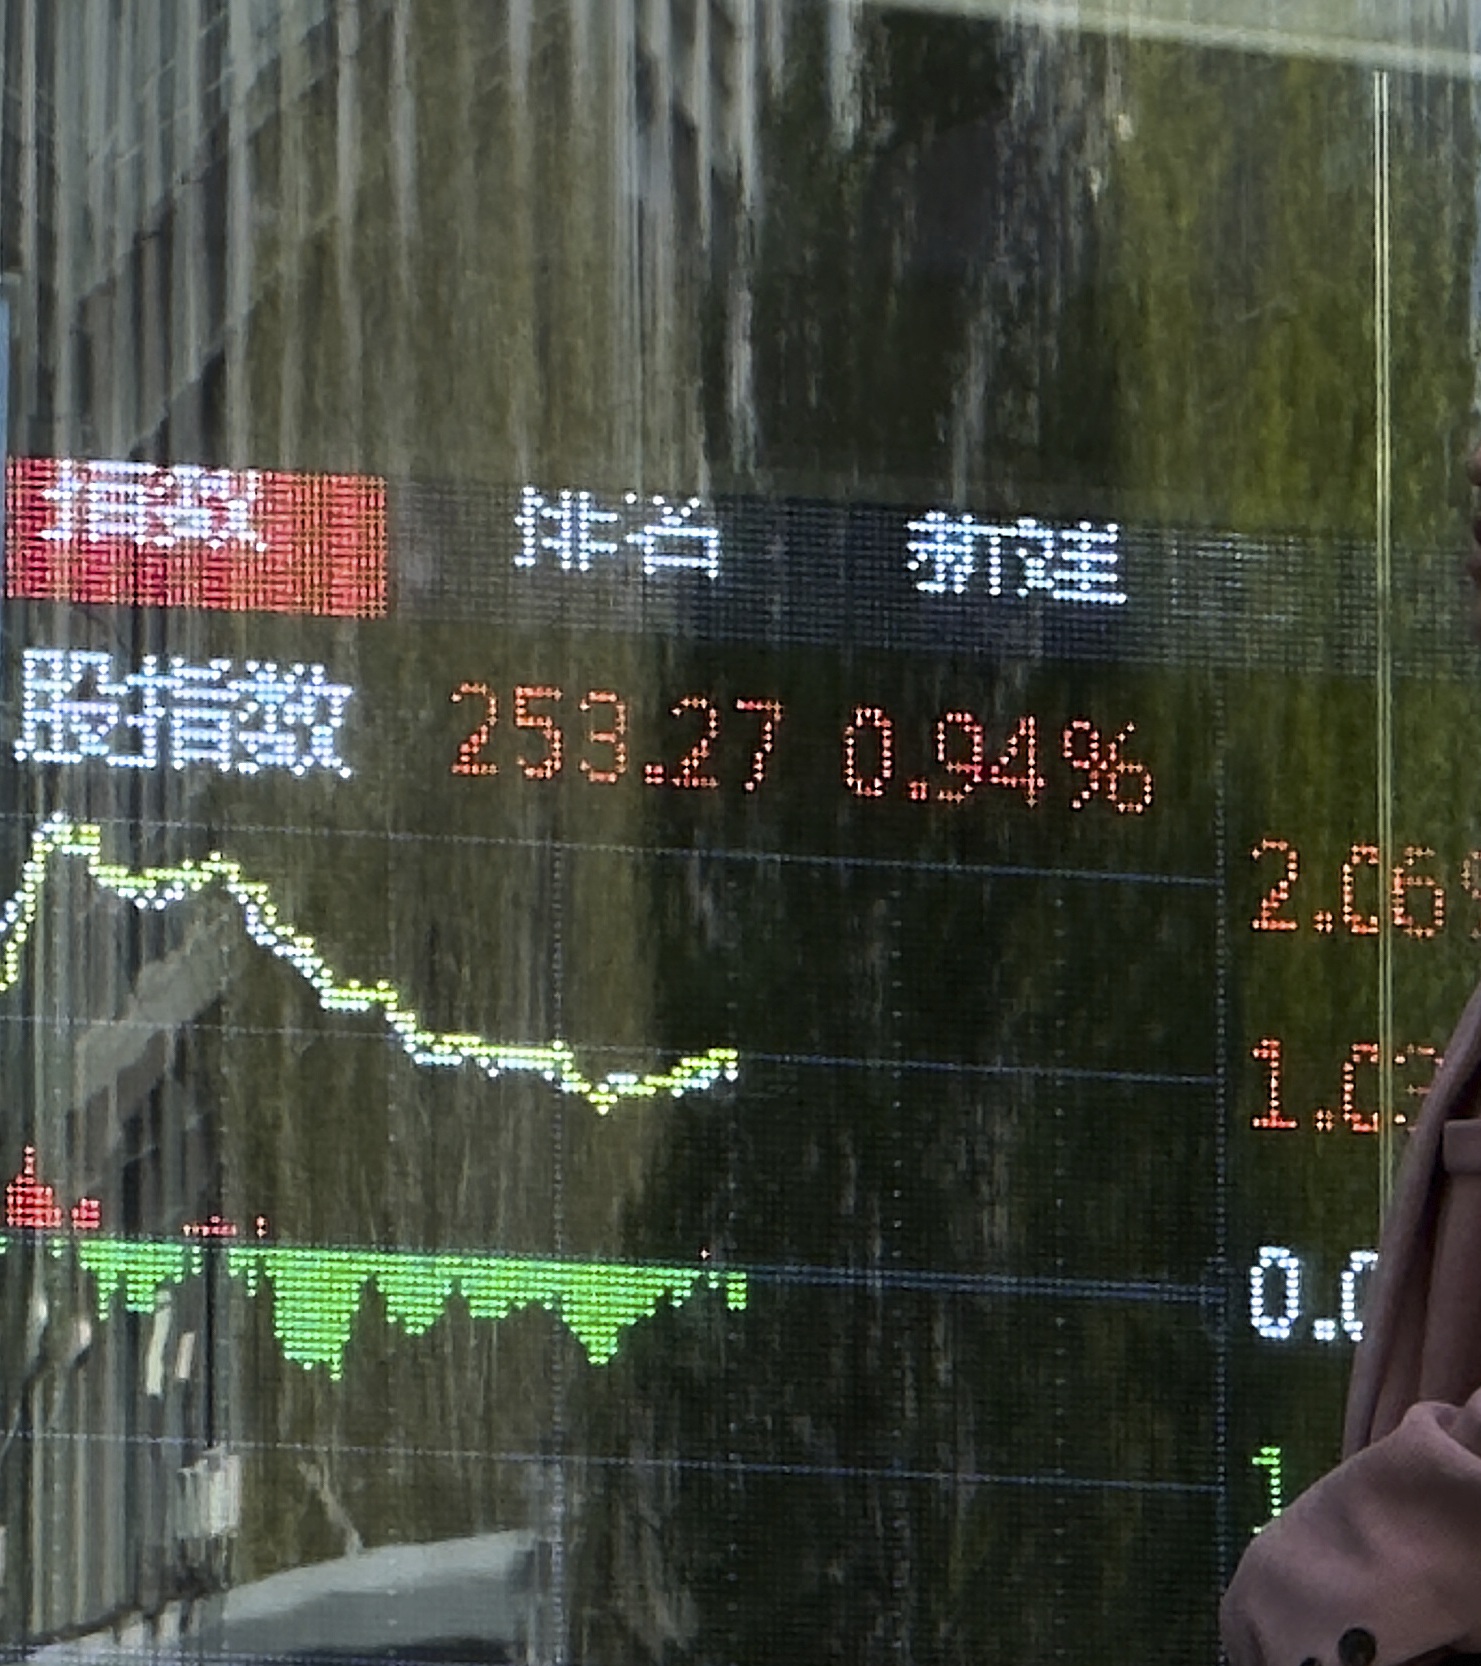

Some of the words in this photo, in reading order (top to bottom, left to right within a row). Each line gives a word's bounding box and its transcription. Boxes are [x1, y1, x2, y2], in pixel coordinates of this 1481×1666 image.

[15, 649, 353, 779] 股指数
[451, 681, 783, 793] 253.27
[843, 704, 1154, 815] 0.94%
